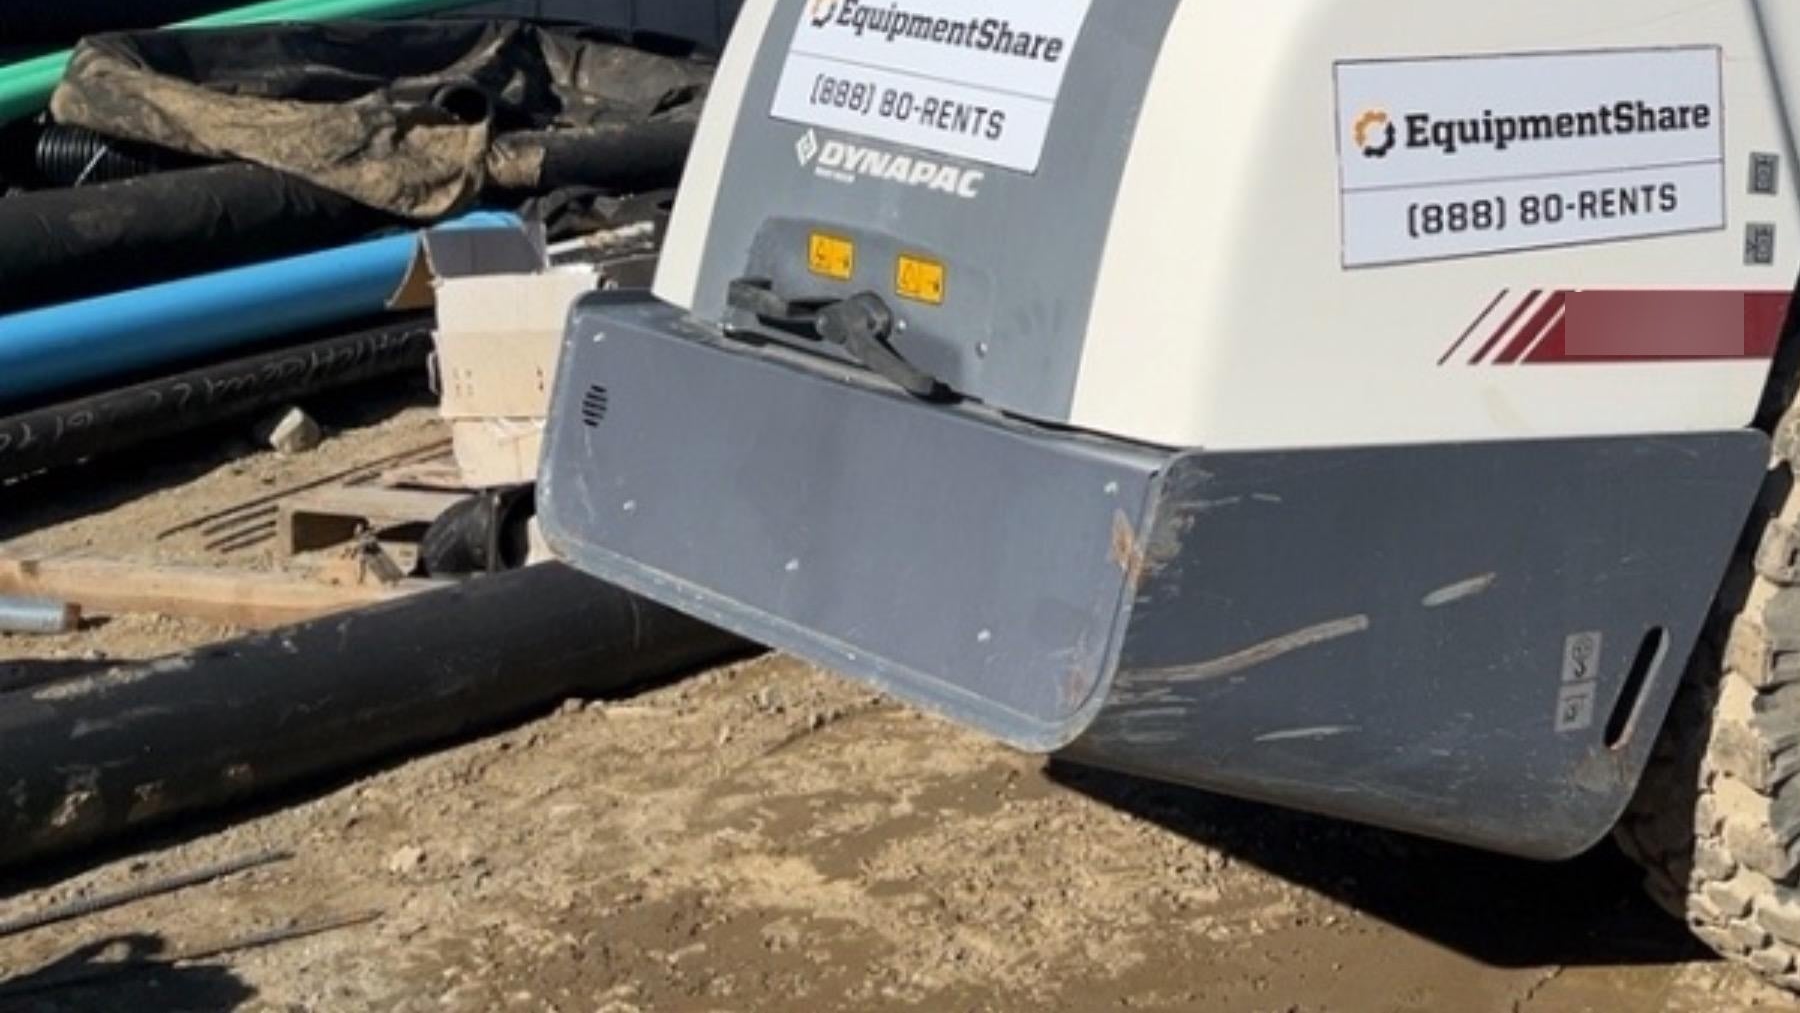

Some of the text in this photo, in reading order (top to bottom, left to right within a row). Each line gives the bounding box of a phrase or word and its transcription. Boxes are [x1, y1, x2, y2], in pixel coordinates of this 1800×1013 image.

[809, 73, 1006, 140] (888) 80-RENTS
[1403, 100, 1712, 155] EquipmentShare
[817, 139, 985, 199] DYNAPAC
[1406, 183, 1679, 239] (888) 80-RENTS
